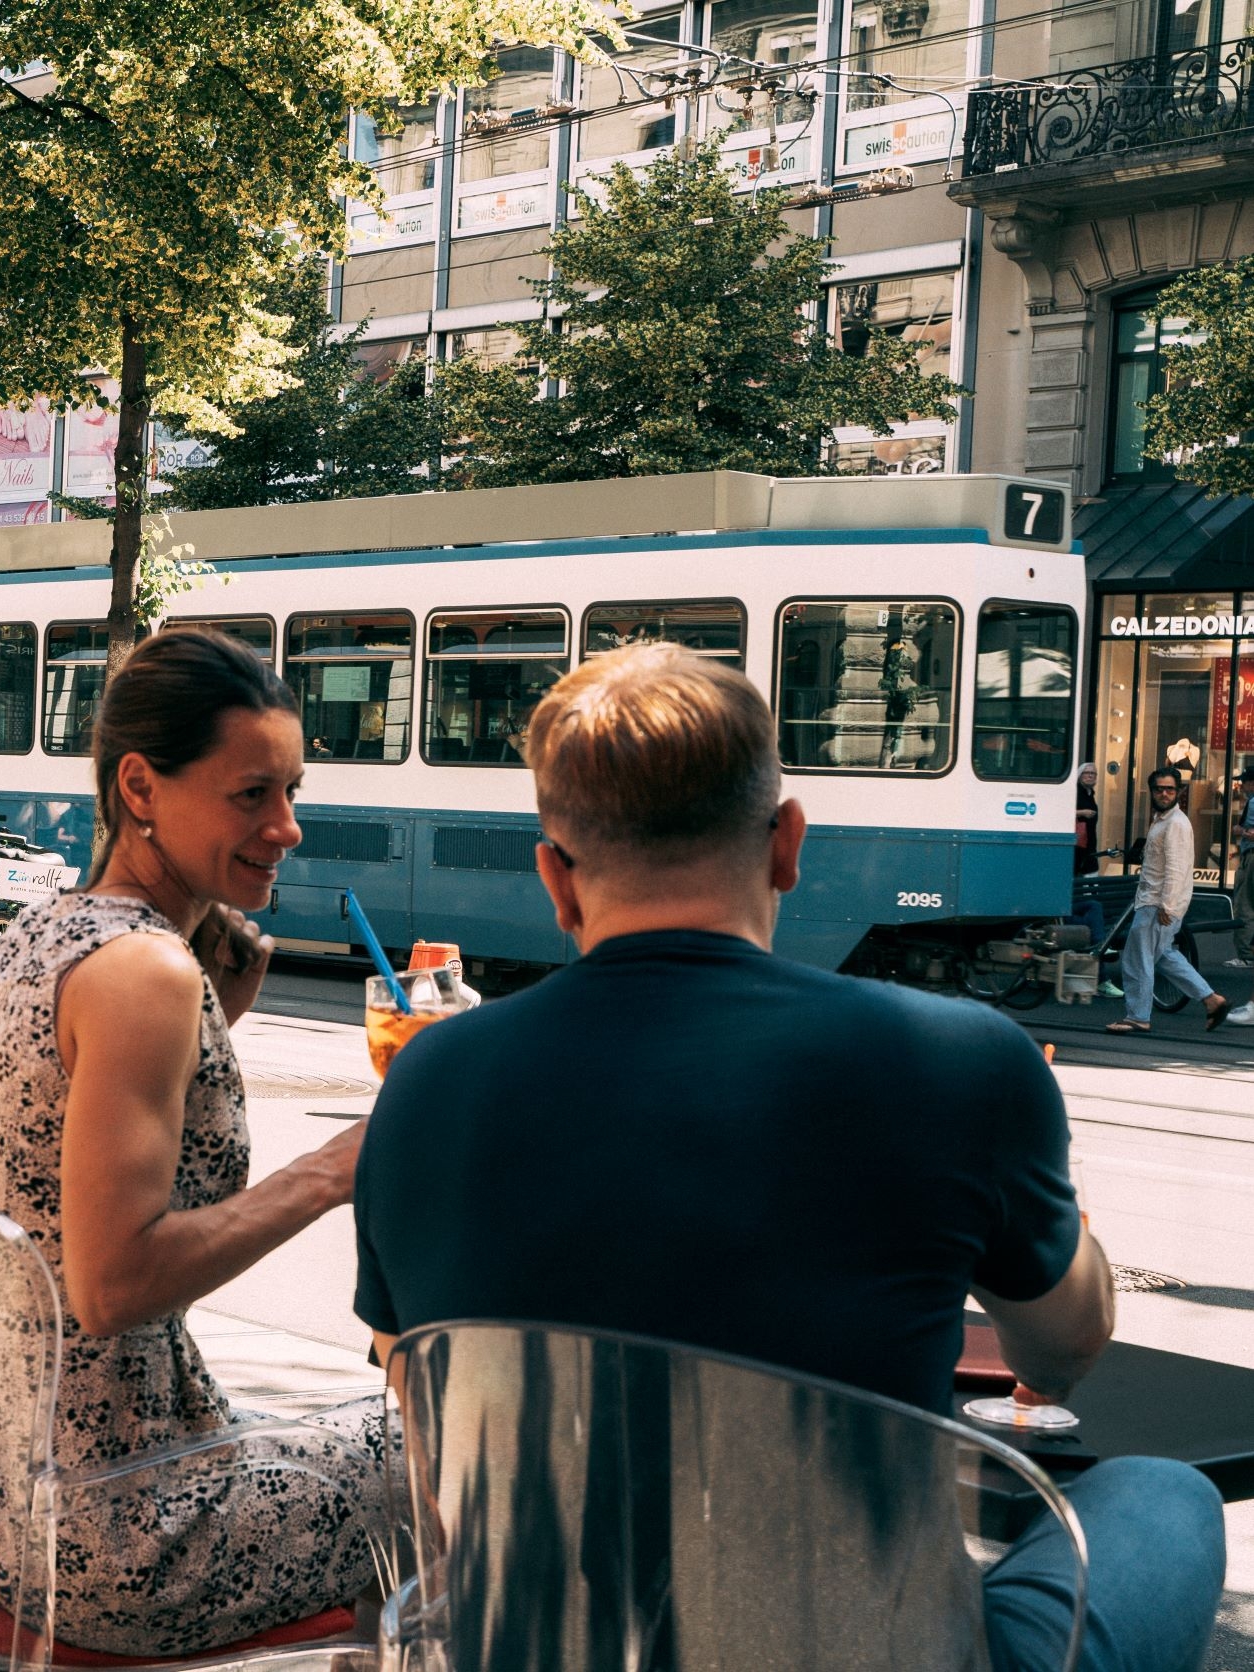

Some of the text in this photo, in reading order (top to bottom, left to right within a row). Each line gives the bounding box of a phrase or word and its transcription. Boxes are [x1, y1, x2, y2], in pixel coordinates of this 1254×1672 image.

[1021, 492, 1043, 535] 7
[1110, 615, 1254, 636] CALZEDONIA
[897, 891, 942, 908] 2095
